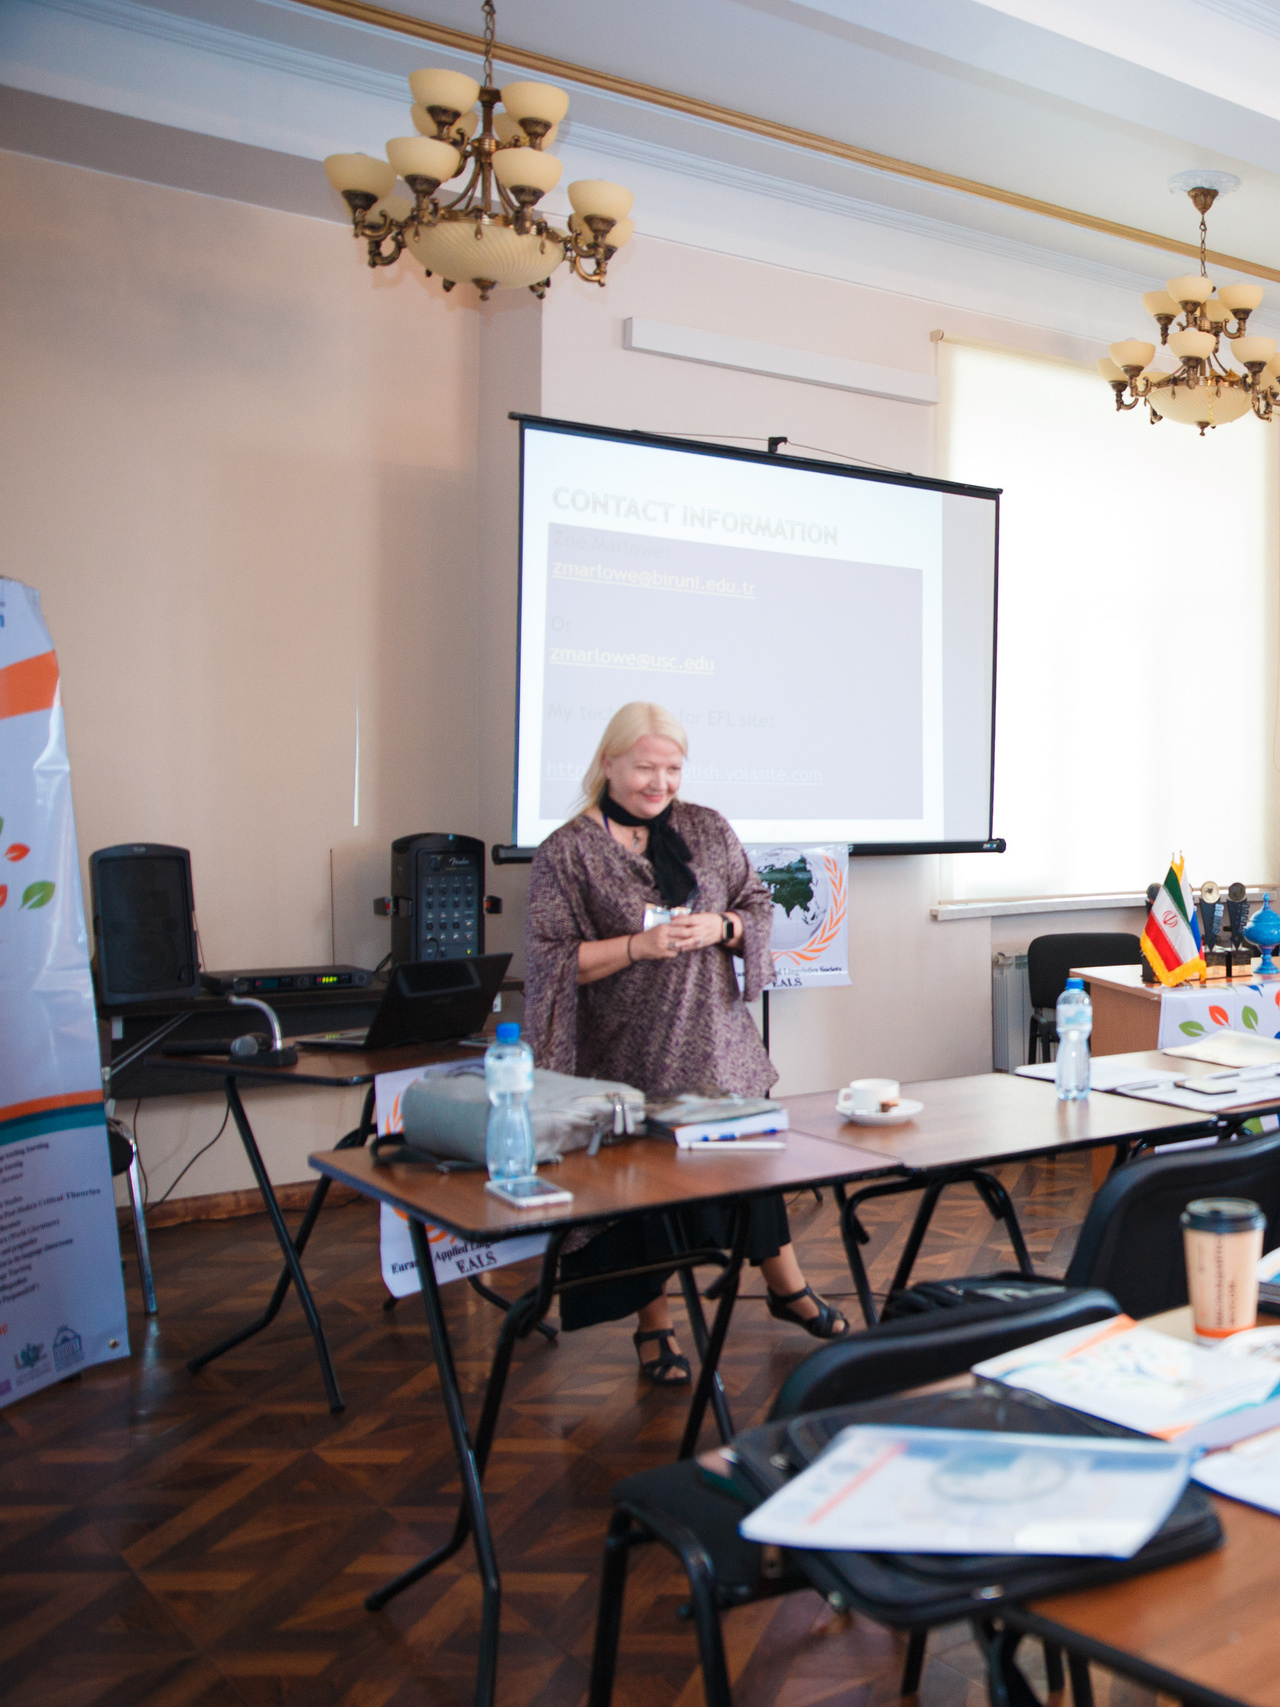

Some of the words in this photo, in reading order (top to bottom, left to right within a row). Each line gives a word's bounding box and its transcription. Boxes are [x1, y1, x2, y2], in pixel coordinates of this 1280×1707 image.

[552, 486, 675, 524] CONTACT
[682, 504, 839, 546] INFORMATION
[552, 561, 756, 597] zmarlowe@biruni.edu.tr
[549, 646, 715, 673] zmarlowe@usc.edu
[434, 1242, 468, 1262] Applied
[456, 1250, 498, 1274] EALS
